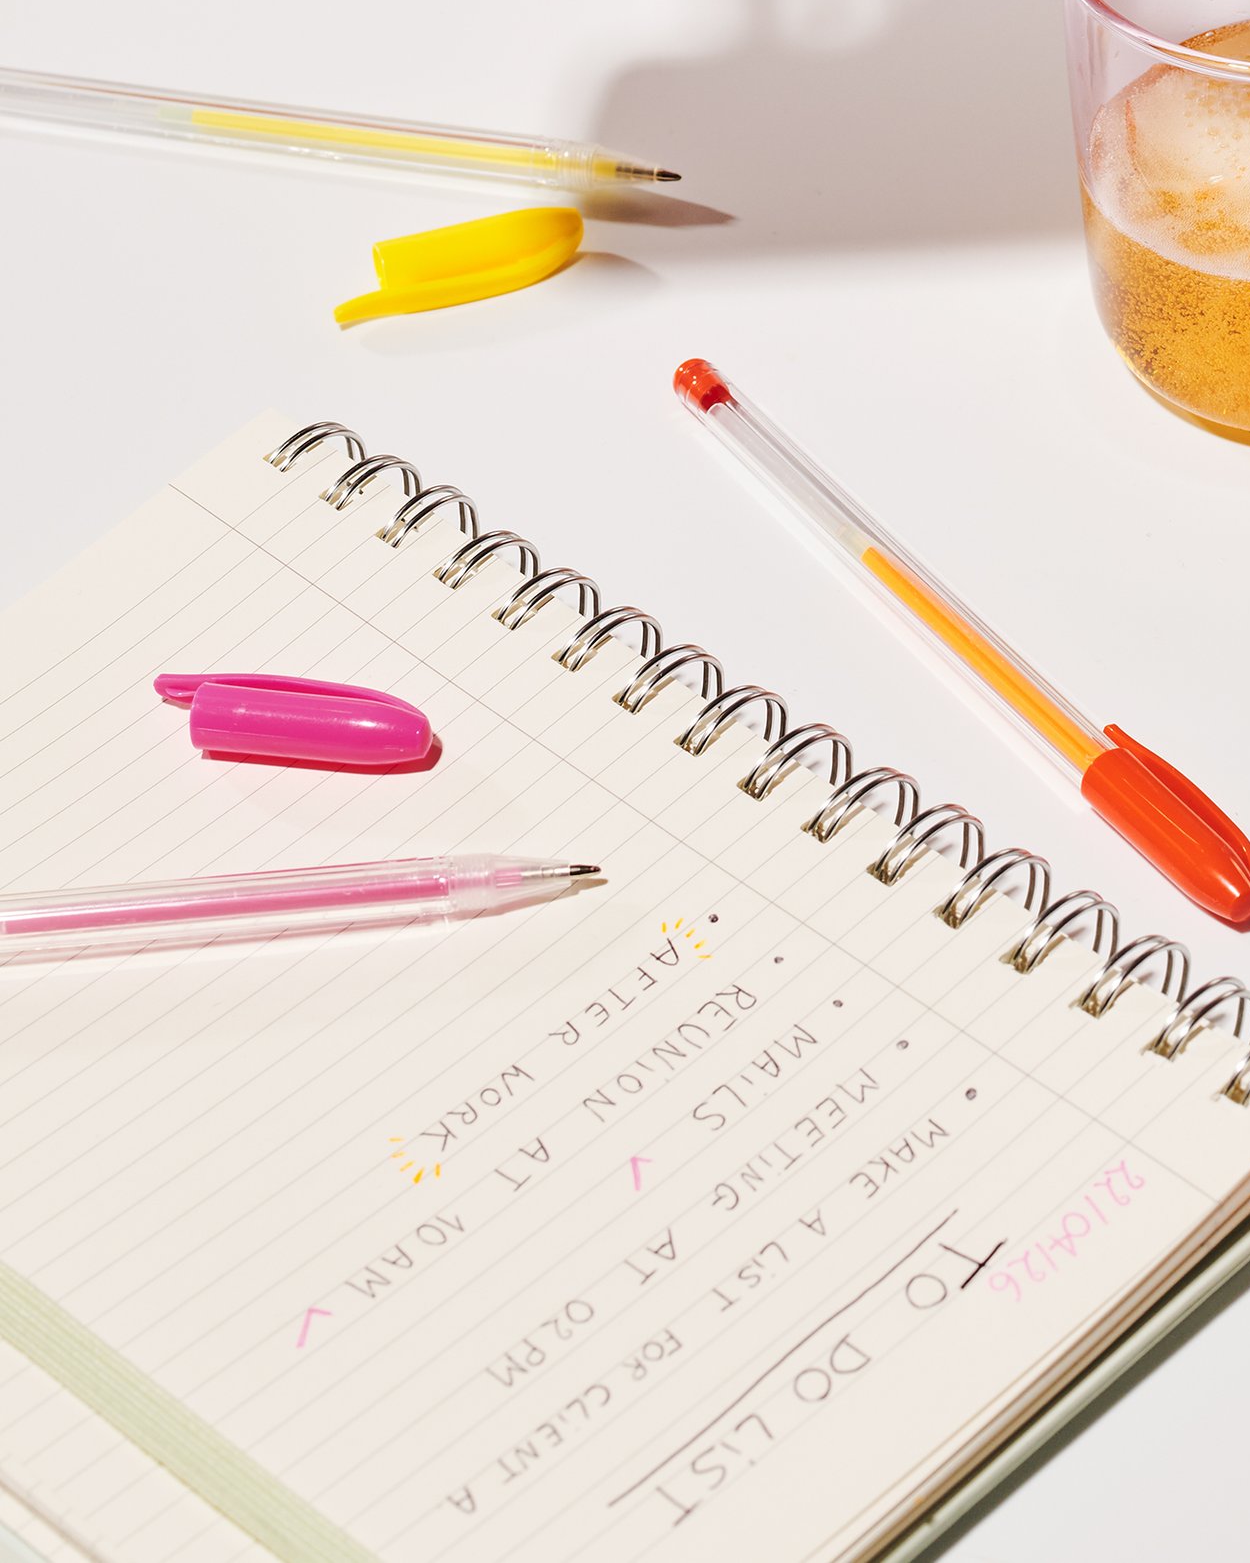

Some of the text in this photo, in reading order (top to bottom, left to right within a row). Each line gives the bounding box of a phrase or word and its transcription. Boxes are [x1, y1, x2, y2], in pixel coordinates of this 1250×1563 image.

[418, 937, 680, 1152] AFTER WORK
[493, 1136, 551, 1192] AT
[848, 1118, 950, 1199] MAKE
[797, 1209, 827, 1237] A
[623, 1228, 677, 1286] AT
[906, 1239, 1008, 1309] TO
[621, 1328, 684, 1381] FOR
[793, 1333, 872, 1402] DO
[445, 1485, 476, 1514] A
